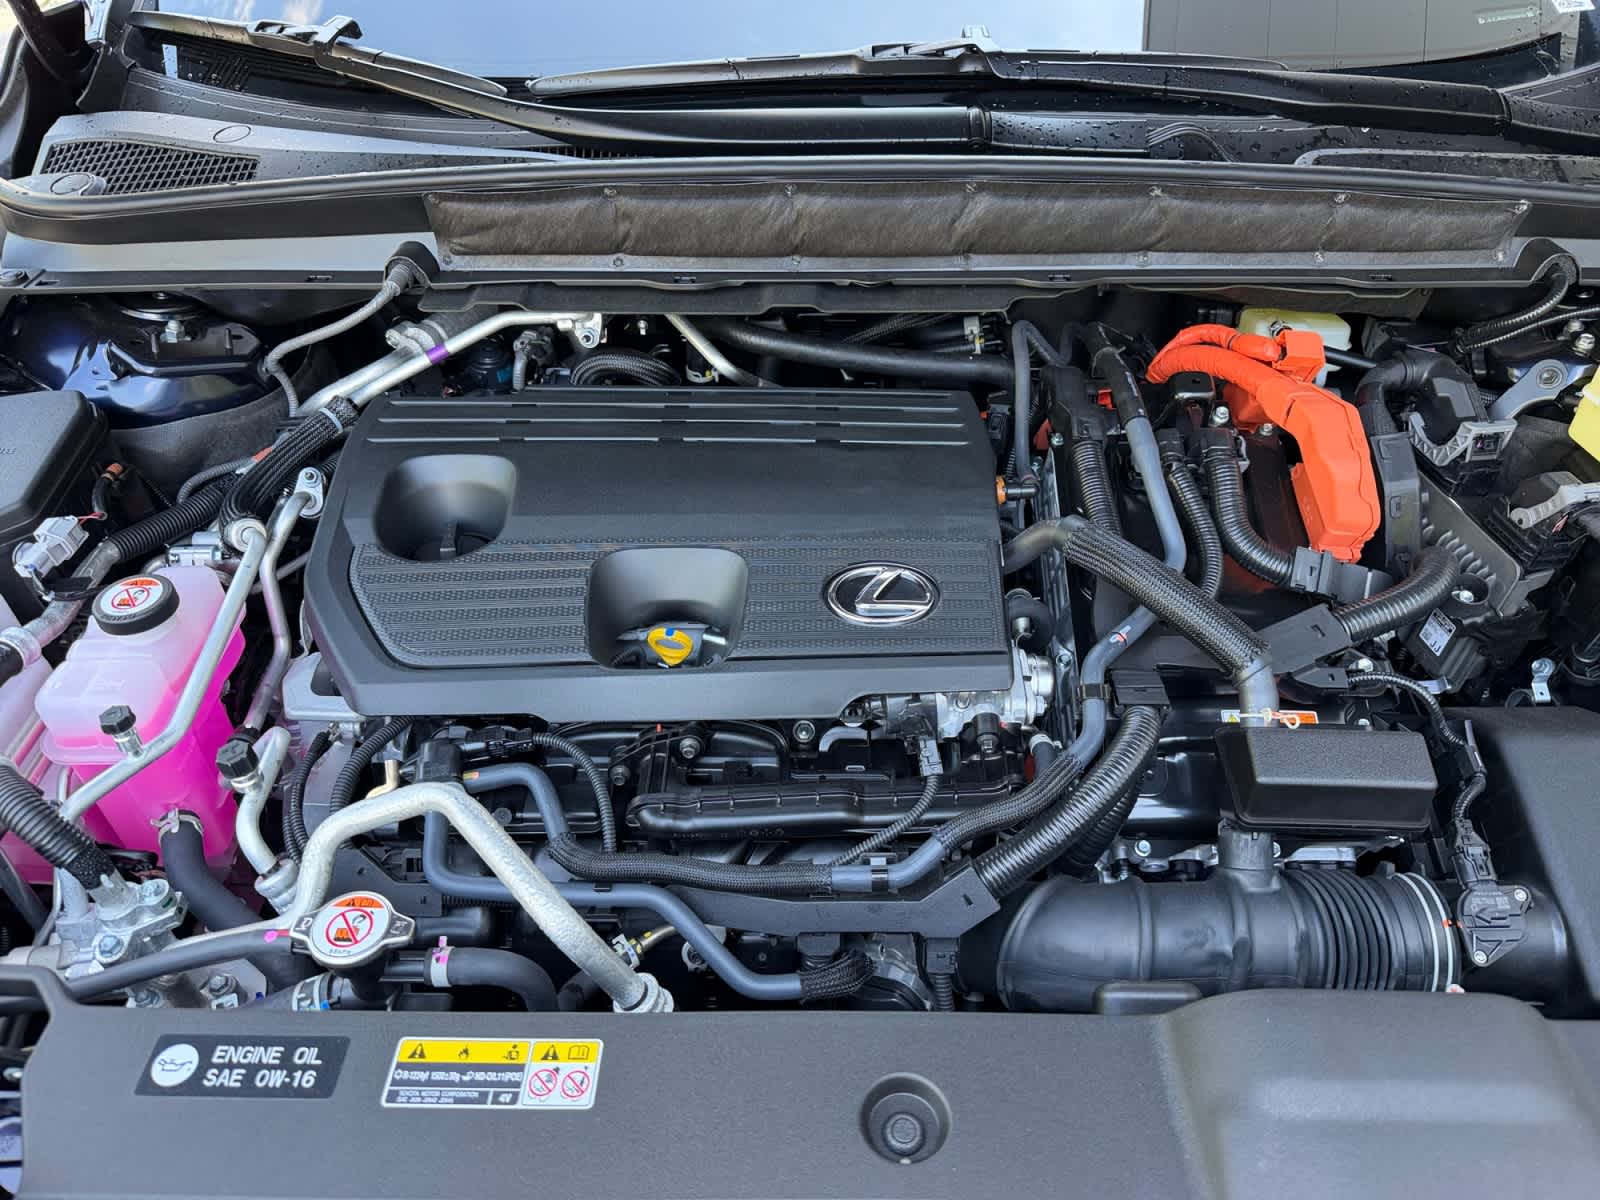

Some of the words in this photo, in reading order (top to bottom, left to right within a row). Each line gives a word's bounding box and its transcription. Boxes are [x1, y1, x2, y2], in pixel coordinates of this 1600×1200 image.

[212, 1045, 285, 1064] ENGINE
[293, 1047, 323, 1065] OIL
[202, 1069, 246, 1087] SAE
[254, 1070, 317, 1088] 0W-16
